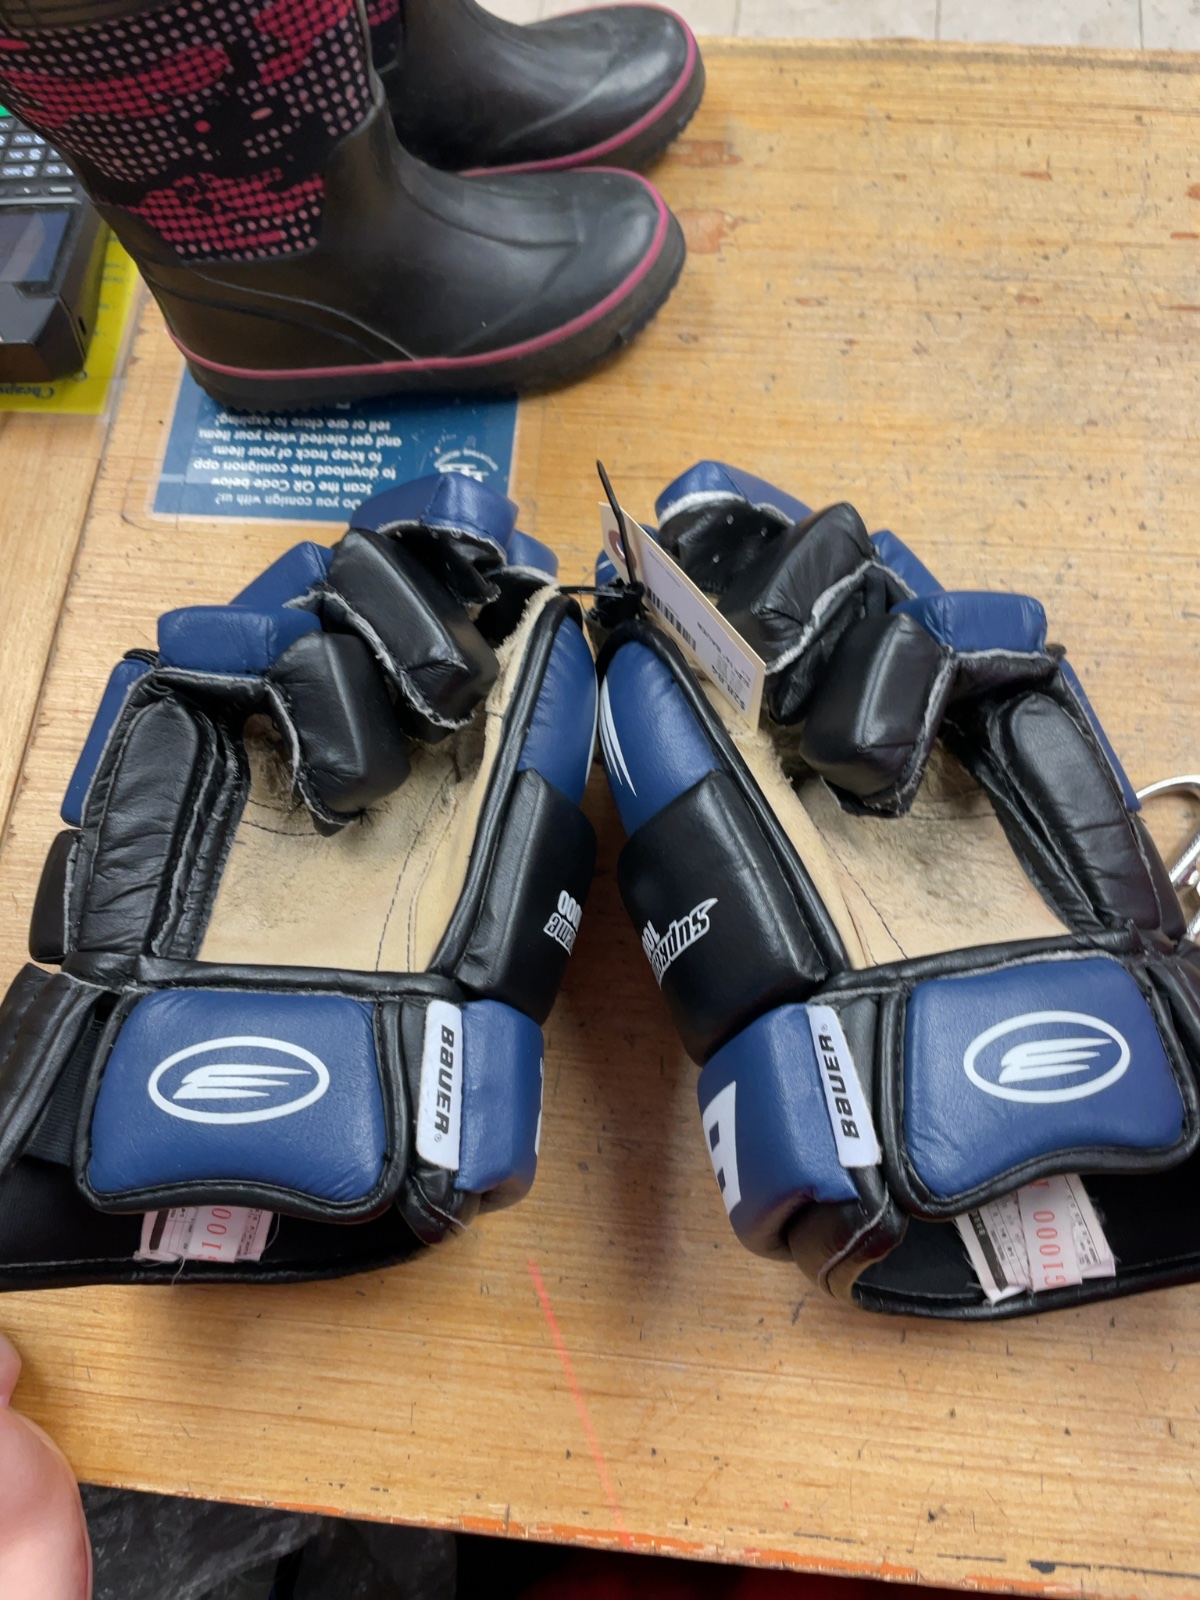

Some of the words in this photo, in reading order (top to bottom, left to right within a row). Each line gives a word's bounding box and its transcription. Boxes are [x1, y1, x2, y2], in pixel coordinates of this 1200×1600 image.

[273, 416, 289, 427] to
[290, 415, 324, 430] close
[326, 417, 350, 430] are
[351, 418, 367, 430] or
[198, 428, 231, 441] items
[233, 429, 262, 441] your
[264, 430, 298, 444] when
[299, 432, 348, 445] alerted
[349, 433, 374, 446] get
[375, 434, 402, 448] and
[212, 445, 245, 457] items
[247, 445, 277, 457] your
[277, 447, 293, 460] of
[295, 446, 329, 460] track
[330, 448, 365, 463] keep
[193, 458, 220, 472] app
[367, 453, 383, 464] to
[290, 465, 312, 477] the
[314, 463, 379, 479] download
[381, 470, 397, 480] to
[210, 476, 250, 489] below
[253, 479, 290, 492] Code
[293, 480, 316, 492] QR
[318, 480, 340, 493] the
[215, 492, 233, 505] us?
[236, 494, 262, 506] with
[265, 493, 313, 507] consign
[315, 498, 340, 508] you
